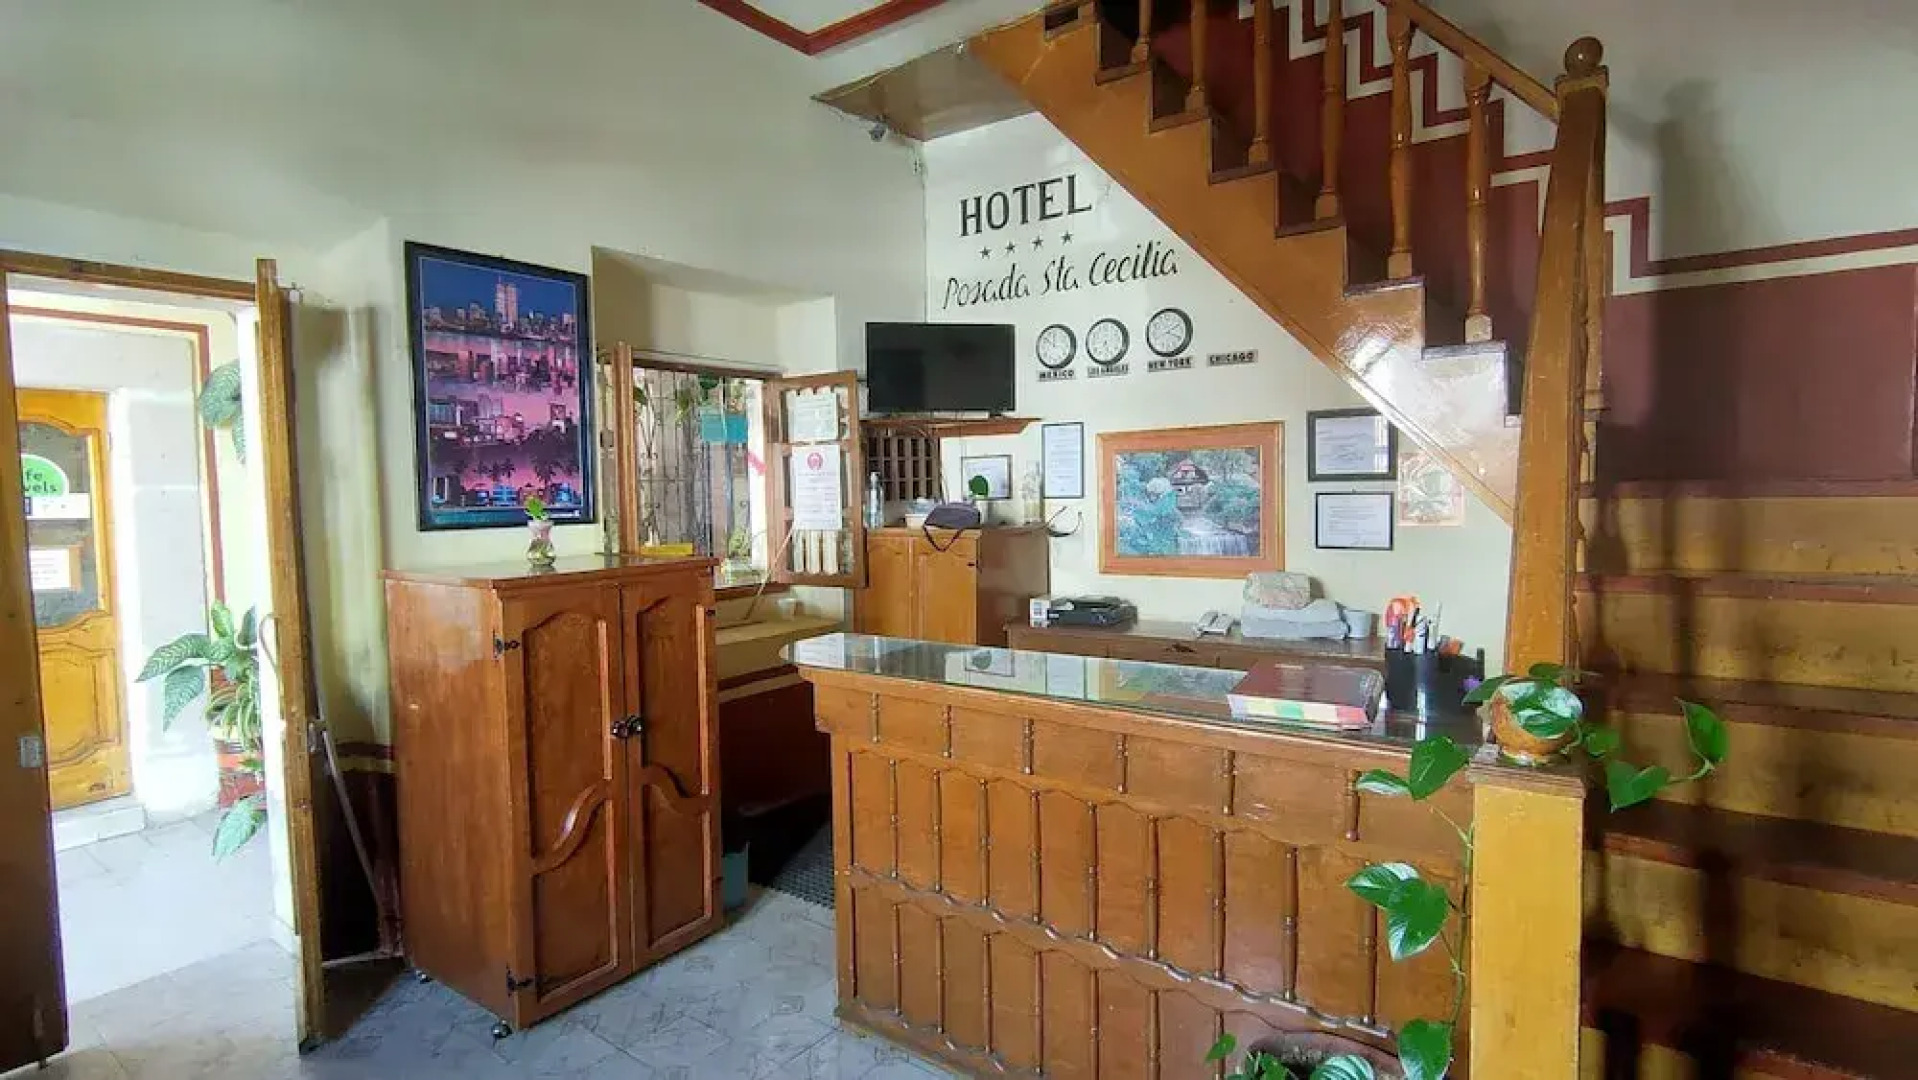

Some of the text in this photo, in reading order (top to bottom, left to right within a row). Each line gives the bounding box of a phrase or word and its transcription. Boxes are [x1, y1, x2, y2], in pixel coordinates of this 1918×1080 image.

[960, 173, 1092, 237] HOTEL
[942, 240, 1179, 310] Posada Sta Cecilia
[1149, 357, 1190, 370] NEW YORK
[1209, 351, 1255, 365] CHICAGO
[1039, 370, 1074, 380] MEXICO
